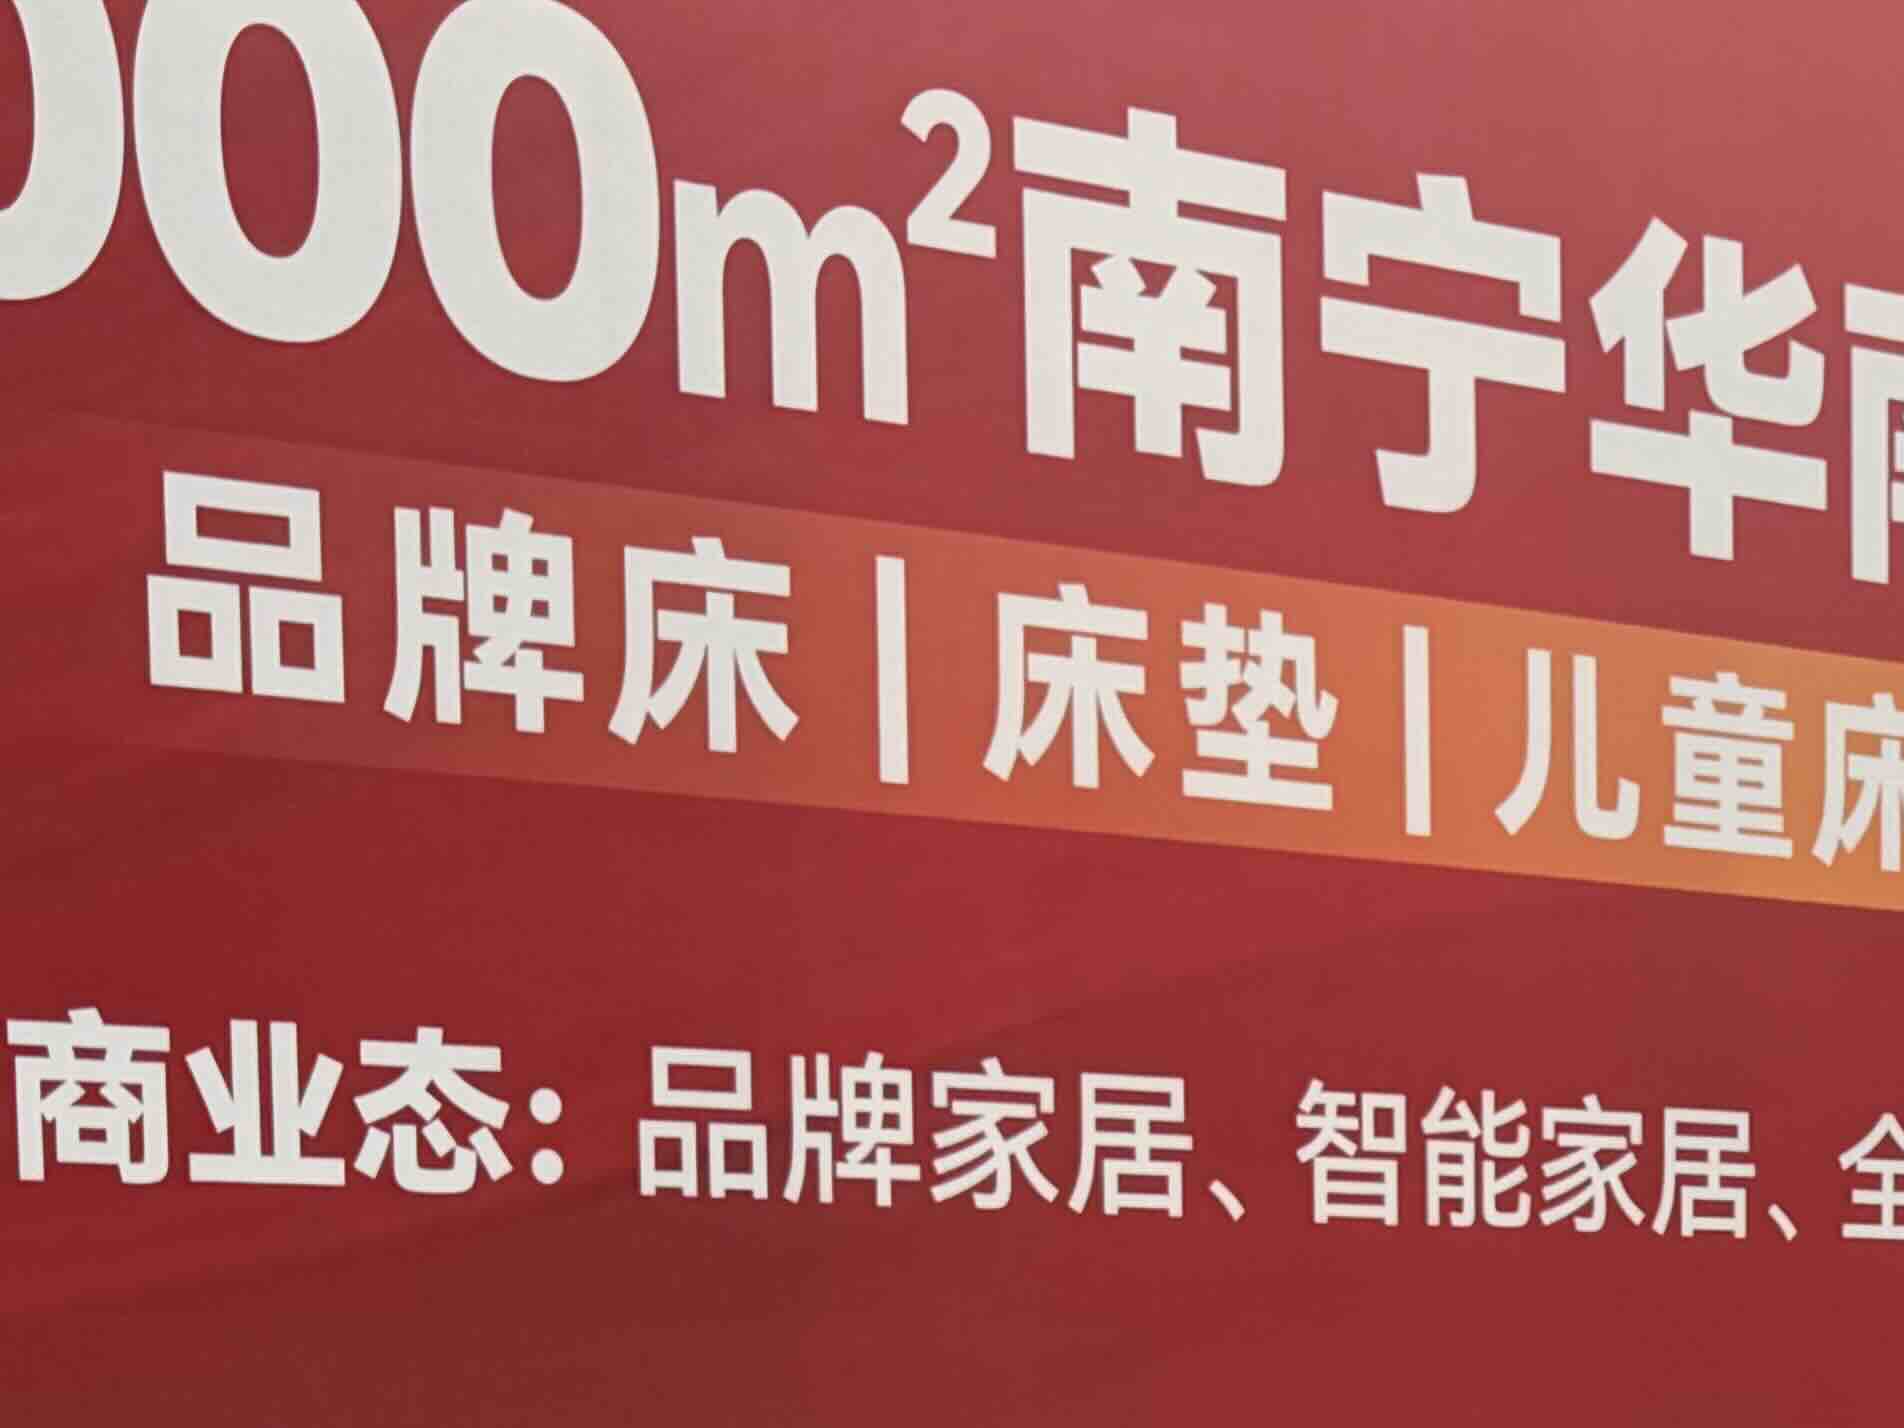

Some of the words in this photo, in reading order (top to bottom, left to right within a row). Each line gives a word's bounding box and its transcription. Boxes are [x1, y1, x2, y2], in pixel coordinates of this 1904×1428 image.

[147, 470, 799, 755] 品牌床
[982, 583, 1338, 812] 床垫
